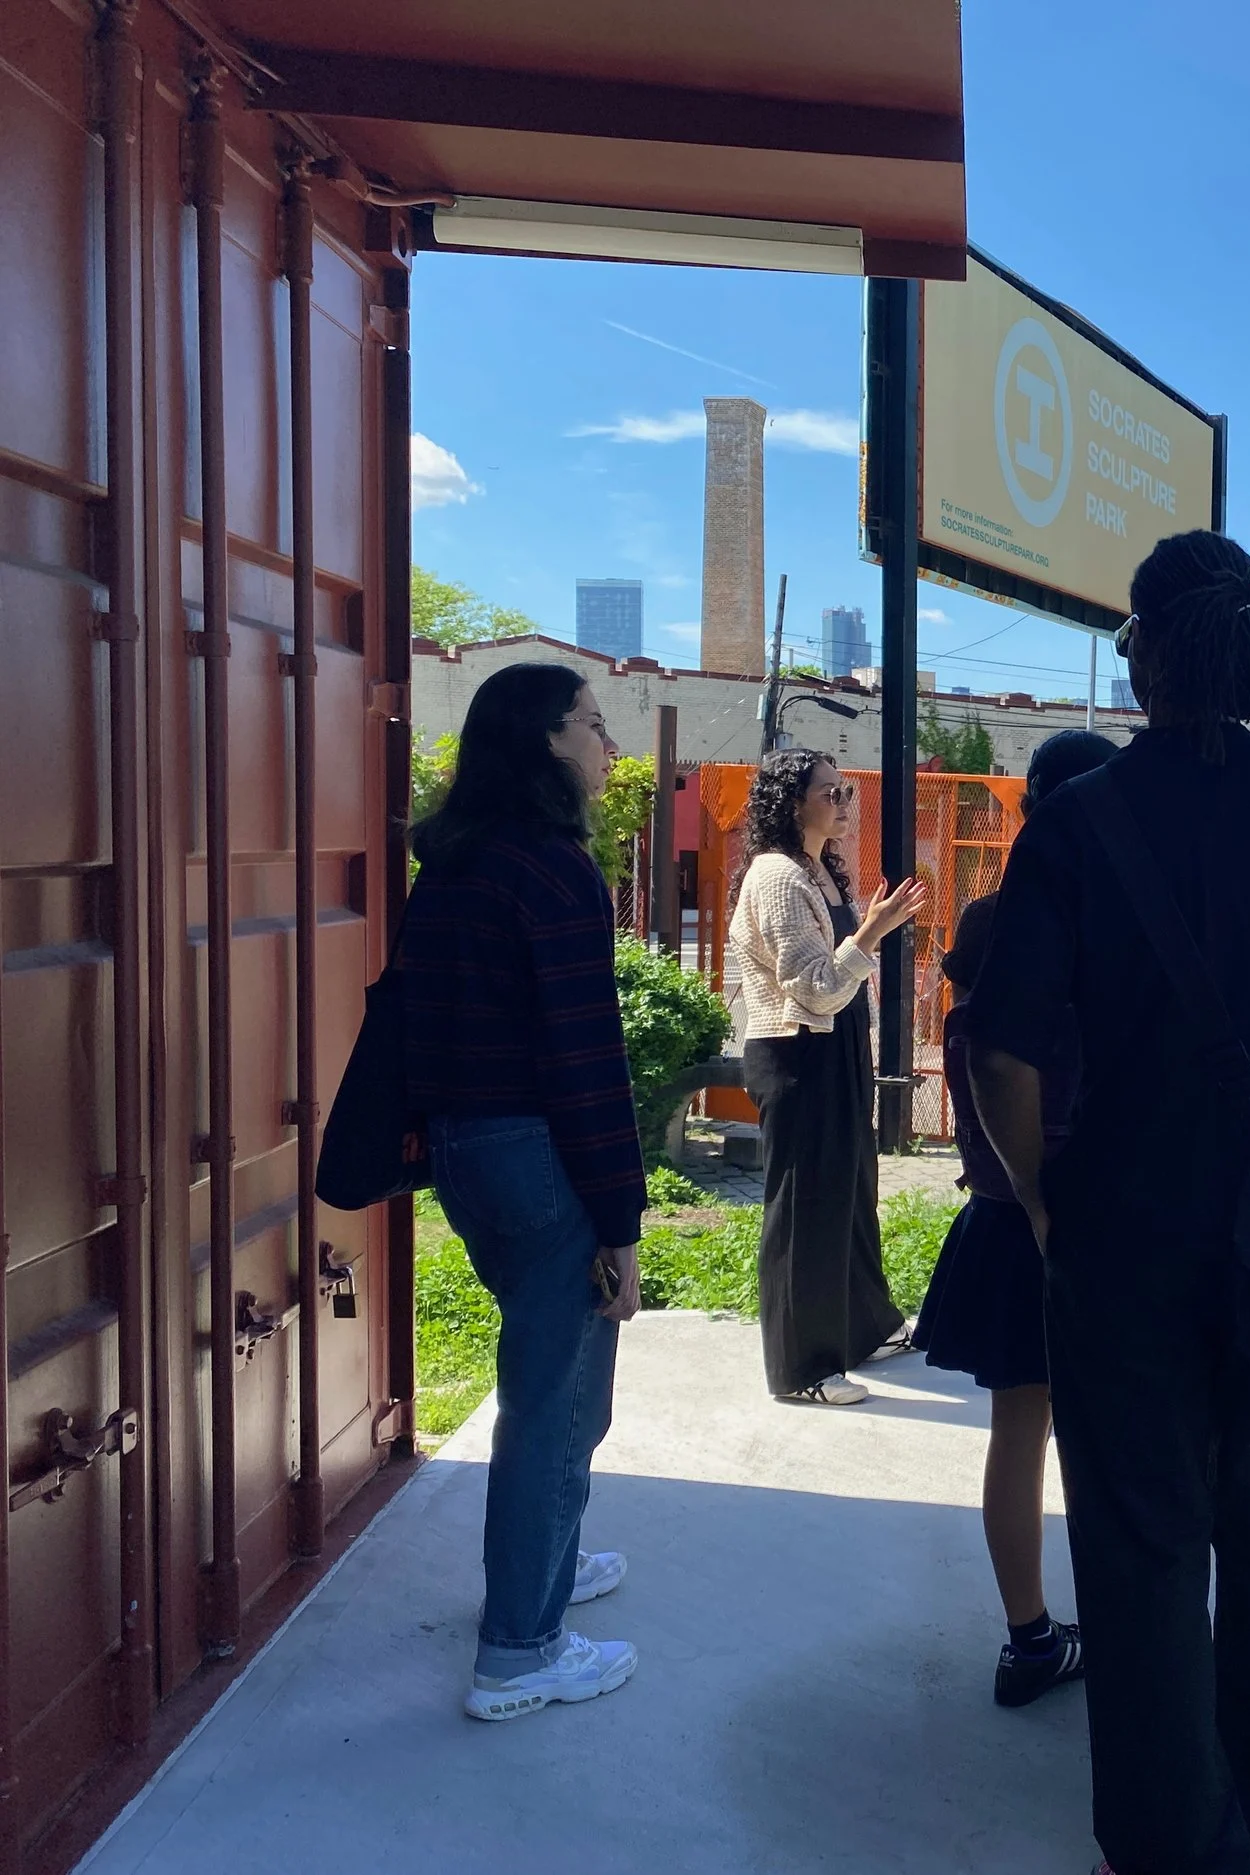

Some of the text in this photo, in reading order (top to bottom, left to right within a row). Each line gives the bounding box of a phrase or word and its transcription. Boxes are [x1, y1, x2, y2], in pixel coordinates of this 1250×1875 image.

[1088, 388, 1171, 465] SOCRATES
[1087, 440, 1177, 516] SCULPTURE
[941, 498, 953, 513] For
[955, 506, 973, 521] more
[1085, 491, 1128, 539] PARK
[941, 515, 1049, 568] SOCRATESSCULPTUREPARK.ORG
